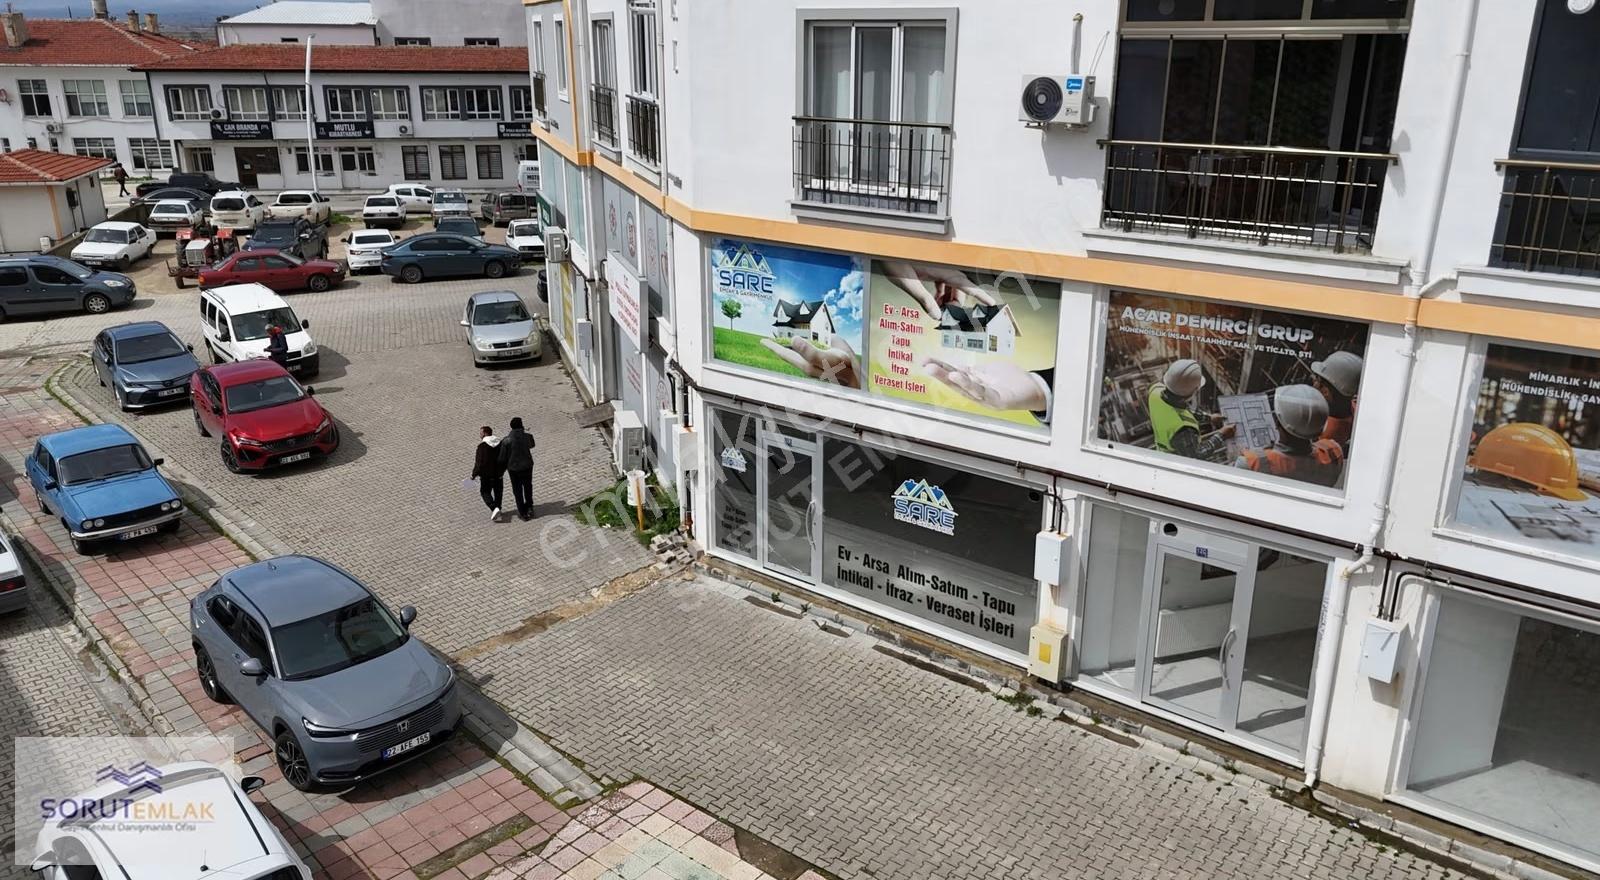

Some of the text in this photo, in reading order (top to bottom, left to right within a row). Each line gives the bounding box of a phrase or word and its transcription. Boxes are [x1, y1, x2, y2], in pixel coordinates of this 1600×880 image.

[333, 123, 356, 131] MUTLU
[719, 270, 774, 294] SARE
[884, 304, 894, 315] Ev
[901, 307, 920, 319] Arsa
[1121, 305, 1314, 344] ACAR DEMİRCİ GRUP
[891, 334, 911, 347] Tapu
[1253, 343, 1265, 352] VE
[874, 373, 905, 389] Veraset
[1528, 370, 1581, 387] MİMARLIK
[1501, 382, 1572, 400] MÜHENDİSLİK
[894, 497, 955, 530] SARE
[837, 545, 852, 562] Ev
[862, 552, 890, 575] Arsa
[897, 564, 969, 601] Alım-Satım
[982, 590, 1016, 617] Tapu
[836, 562, 874, 591] İntikal
[885, 581, 914, 605] İfraz
[925, 594, 976, 626] Veraset
[979, 609, 1015, 639] İşleri
[387, 747, 397, 757] 22
[416, 733, 430, 745] 155
